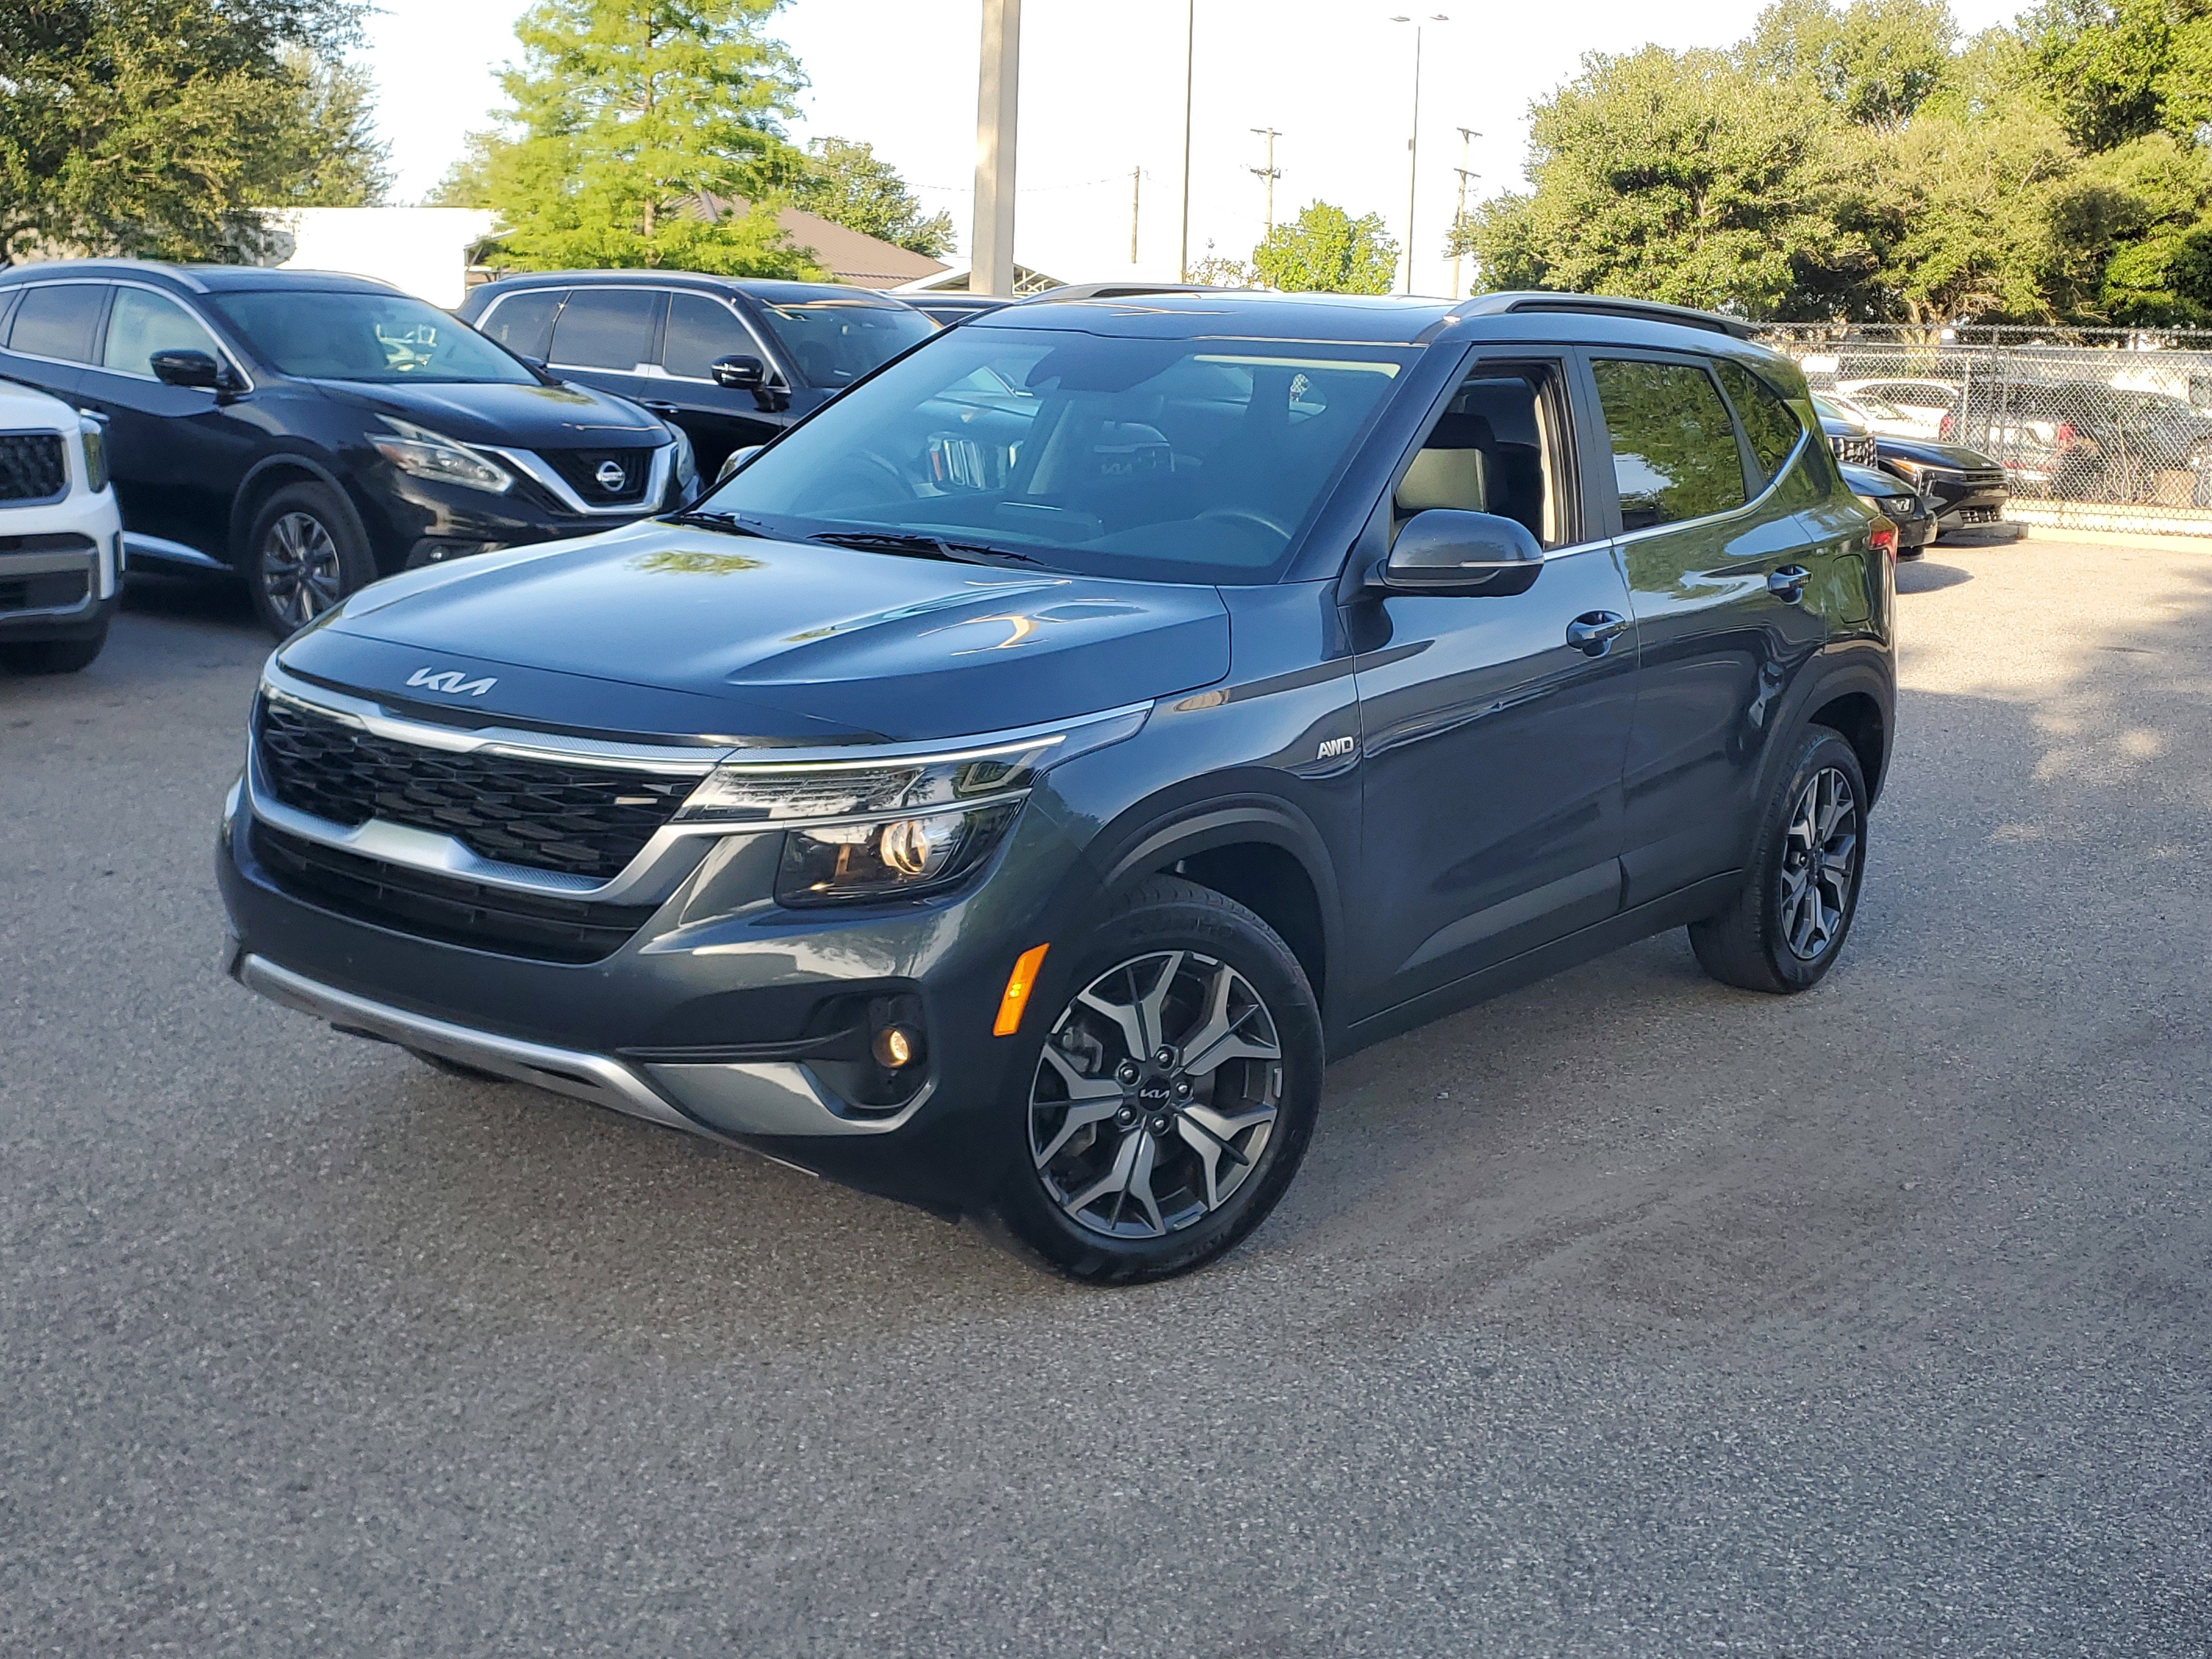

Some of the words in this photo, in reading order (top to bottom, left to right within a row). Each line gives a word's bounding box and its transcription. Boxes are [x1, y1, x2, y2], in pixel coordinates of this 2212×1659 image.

[405, 666, 498, 697] KIA
[1317, 736, 1355, 760] AWD
[1139, 1088, 1170, 1099] KIA
